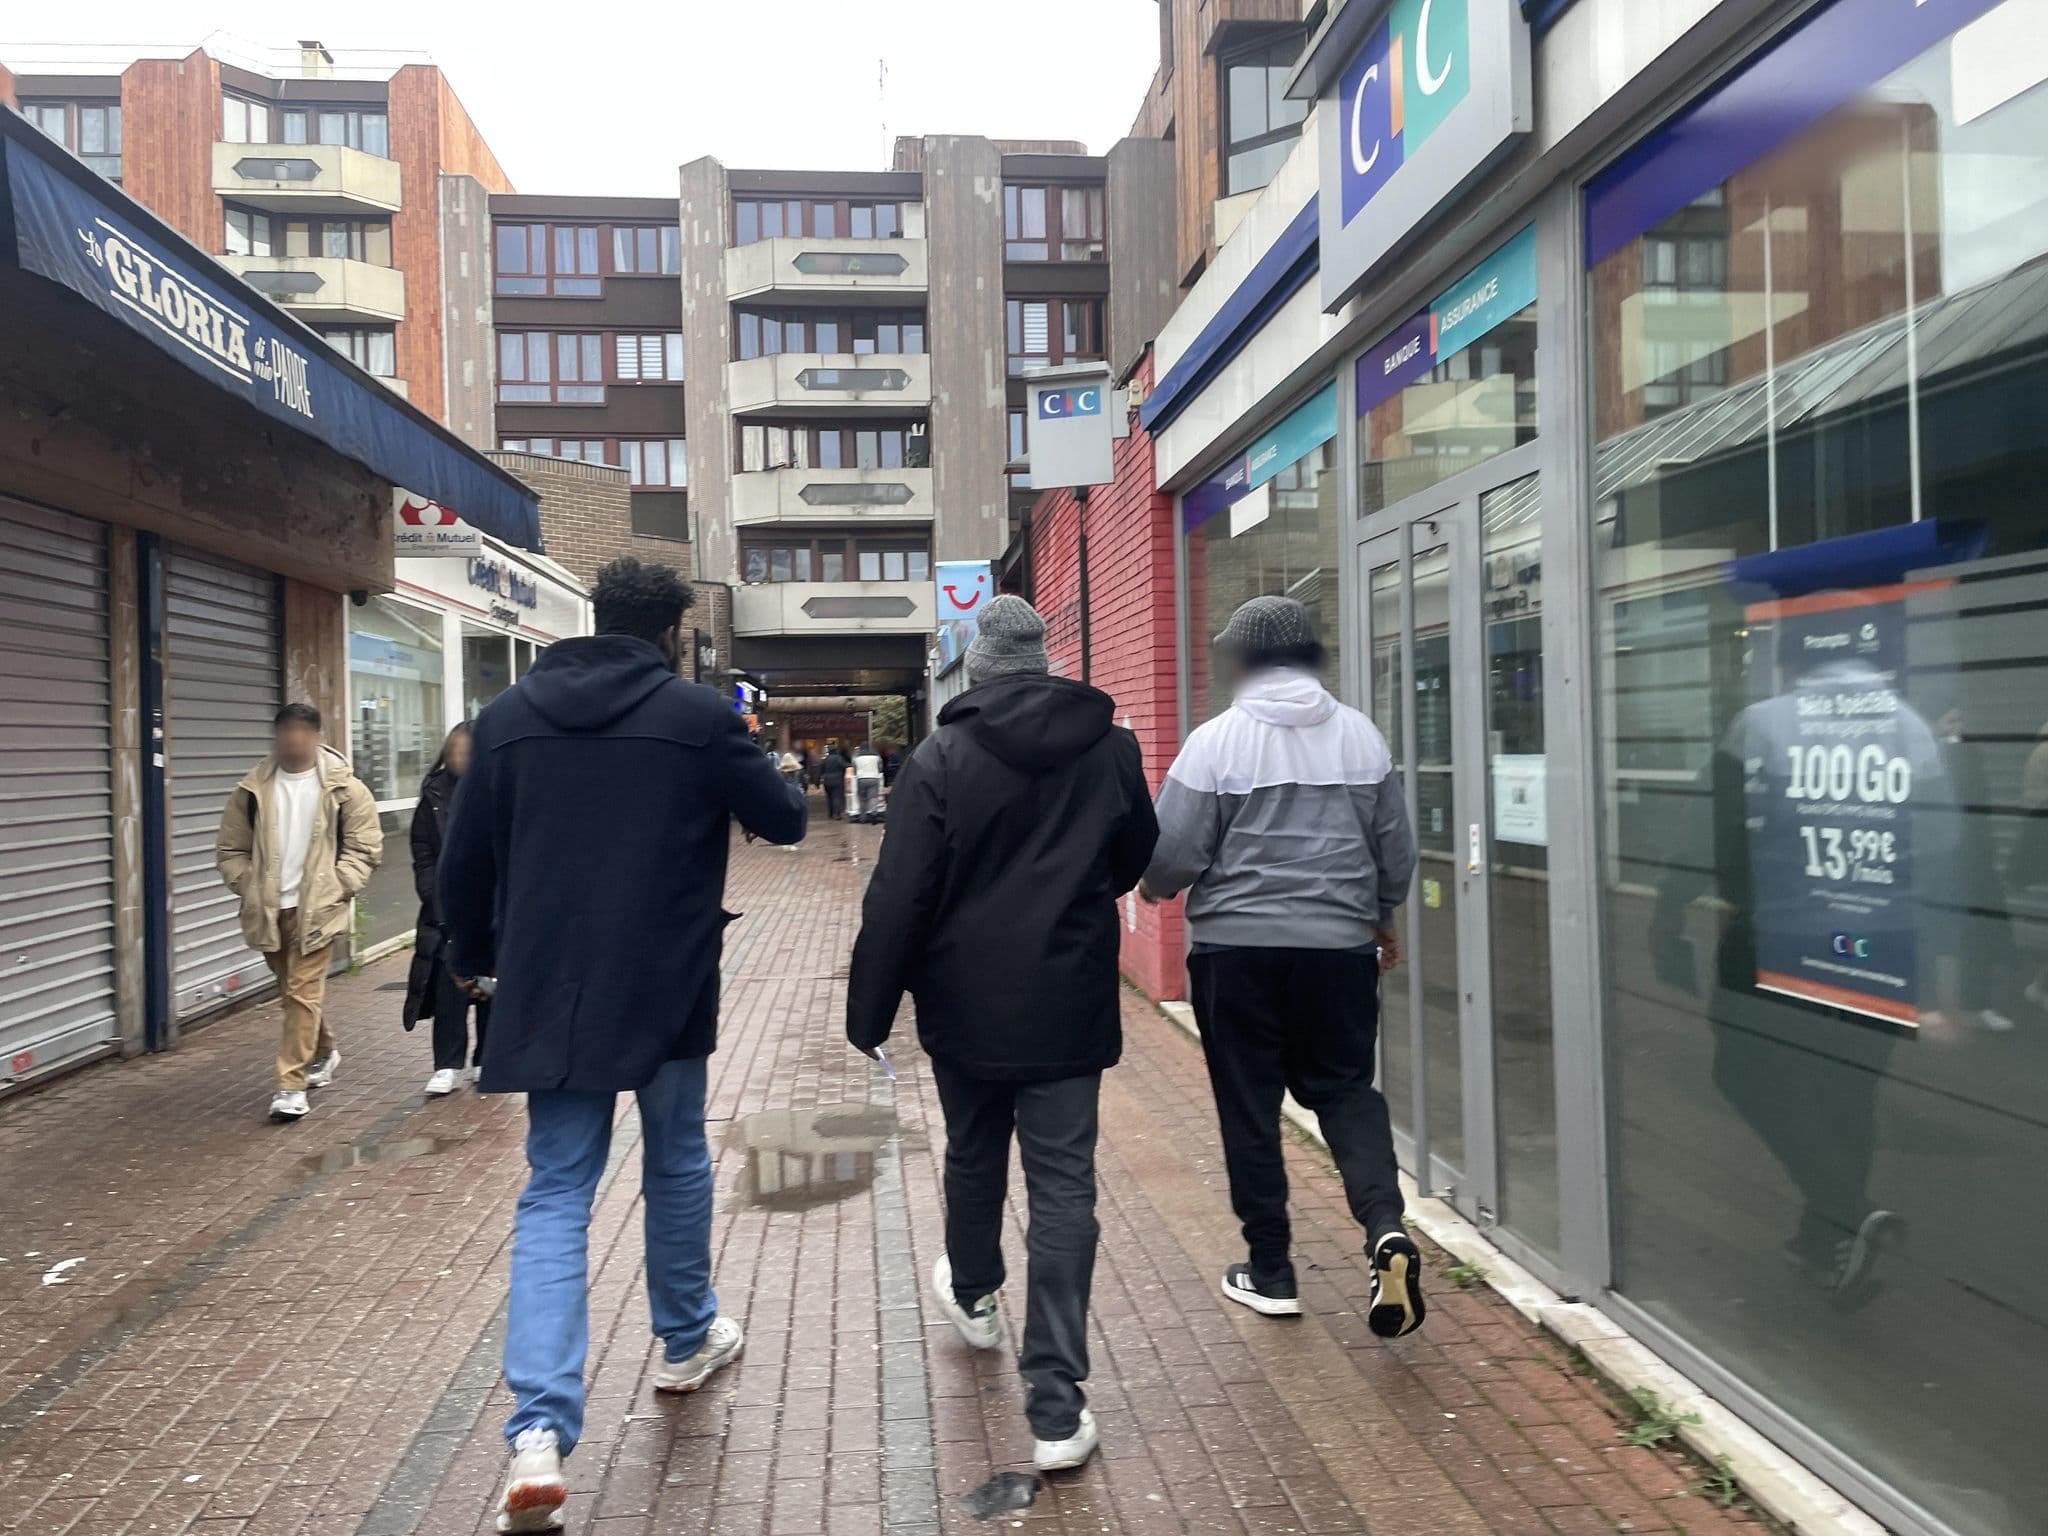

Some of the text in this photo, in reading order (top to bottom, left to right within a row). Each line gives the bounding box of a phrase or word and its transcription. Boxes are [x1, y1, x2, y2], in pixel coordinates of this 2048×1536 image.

[104, 237, 253, 373] GLORIA
[1383, 276, 1499, 376] BANQUE ASSURANCE
[270, 337, 314, 419] PADRE
[1043, 391, 1095, 414] CIC
[393, 531, 476, 543] rédit Mutuel
